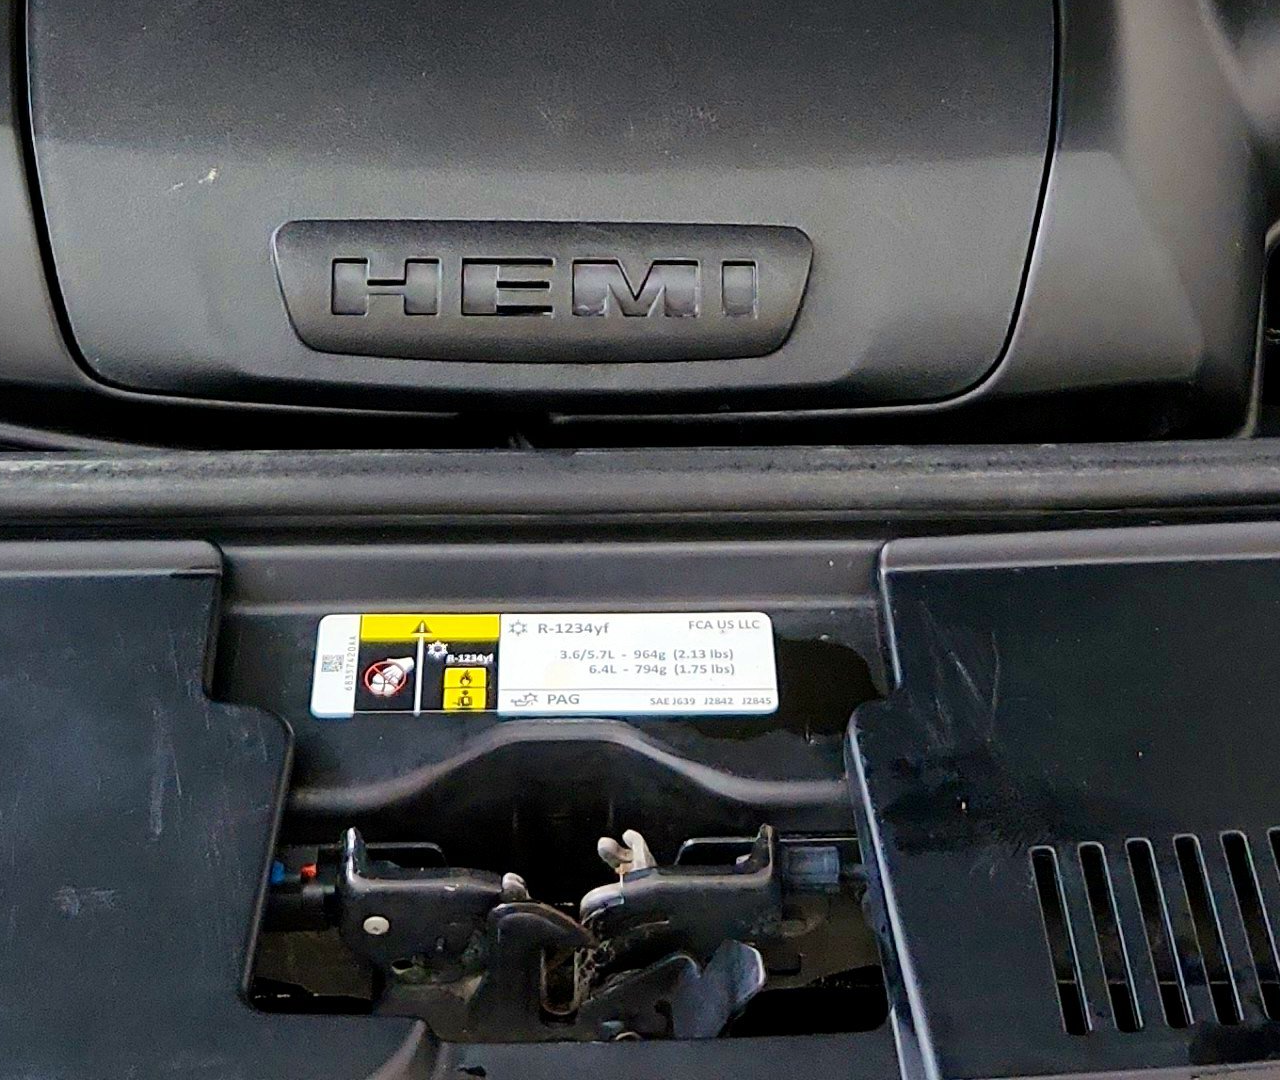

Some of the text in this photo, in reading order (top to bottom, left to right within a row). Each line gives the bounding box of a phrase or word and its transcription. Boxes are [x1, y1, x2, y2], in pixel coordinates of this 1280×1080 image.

[330, 257, 759, 318] HEMI
[537, 623, 610, 636] R-1234yf
[688, 620, 760, 629] FCA US LLC
[446, 653, 494, 665] R-1234yf
[560, 649, 616, 661] 3.6/5.7L
[633, 650, 666, 661] 964g
[673, 649, 706, 661] (2.13
[710, 649, 734, 661] lbs)
[588, 664, 618, 674] 6.4L
[635, 664, 667, 676] 794g
[674, 664, 707, 675] (1.75
[711, 664, 735, 675] lbs)
[547, 694, 580, 705] PAG
[650, 697, 772, 705] SAE J639 J2842 J2845
